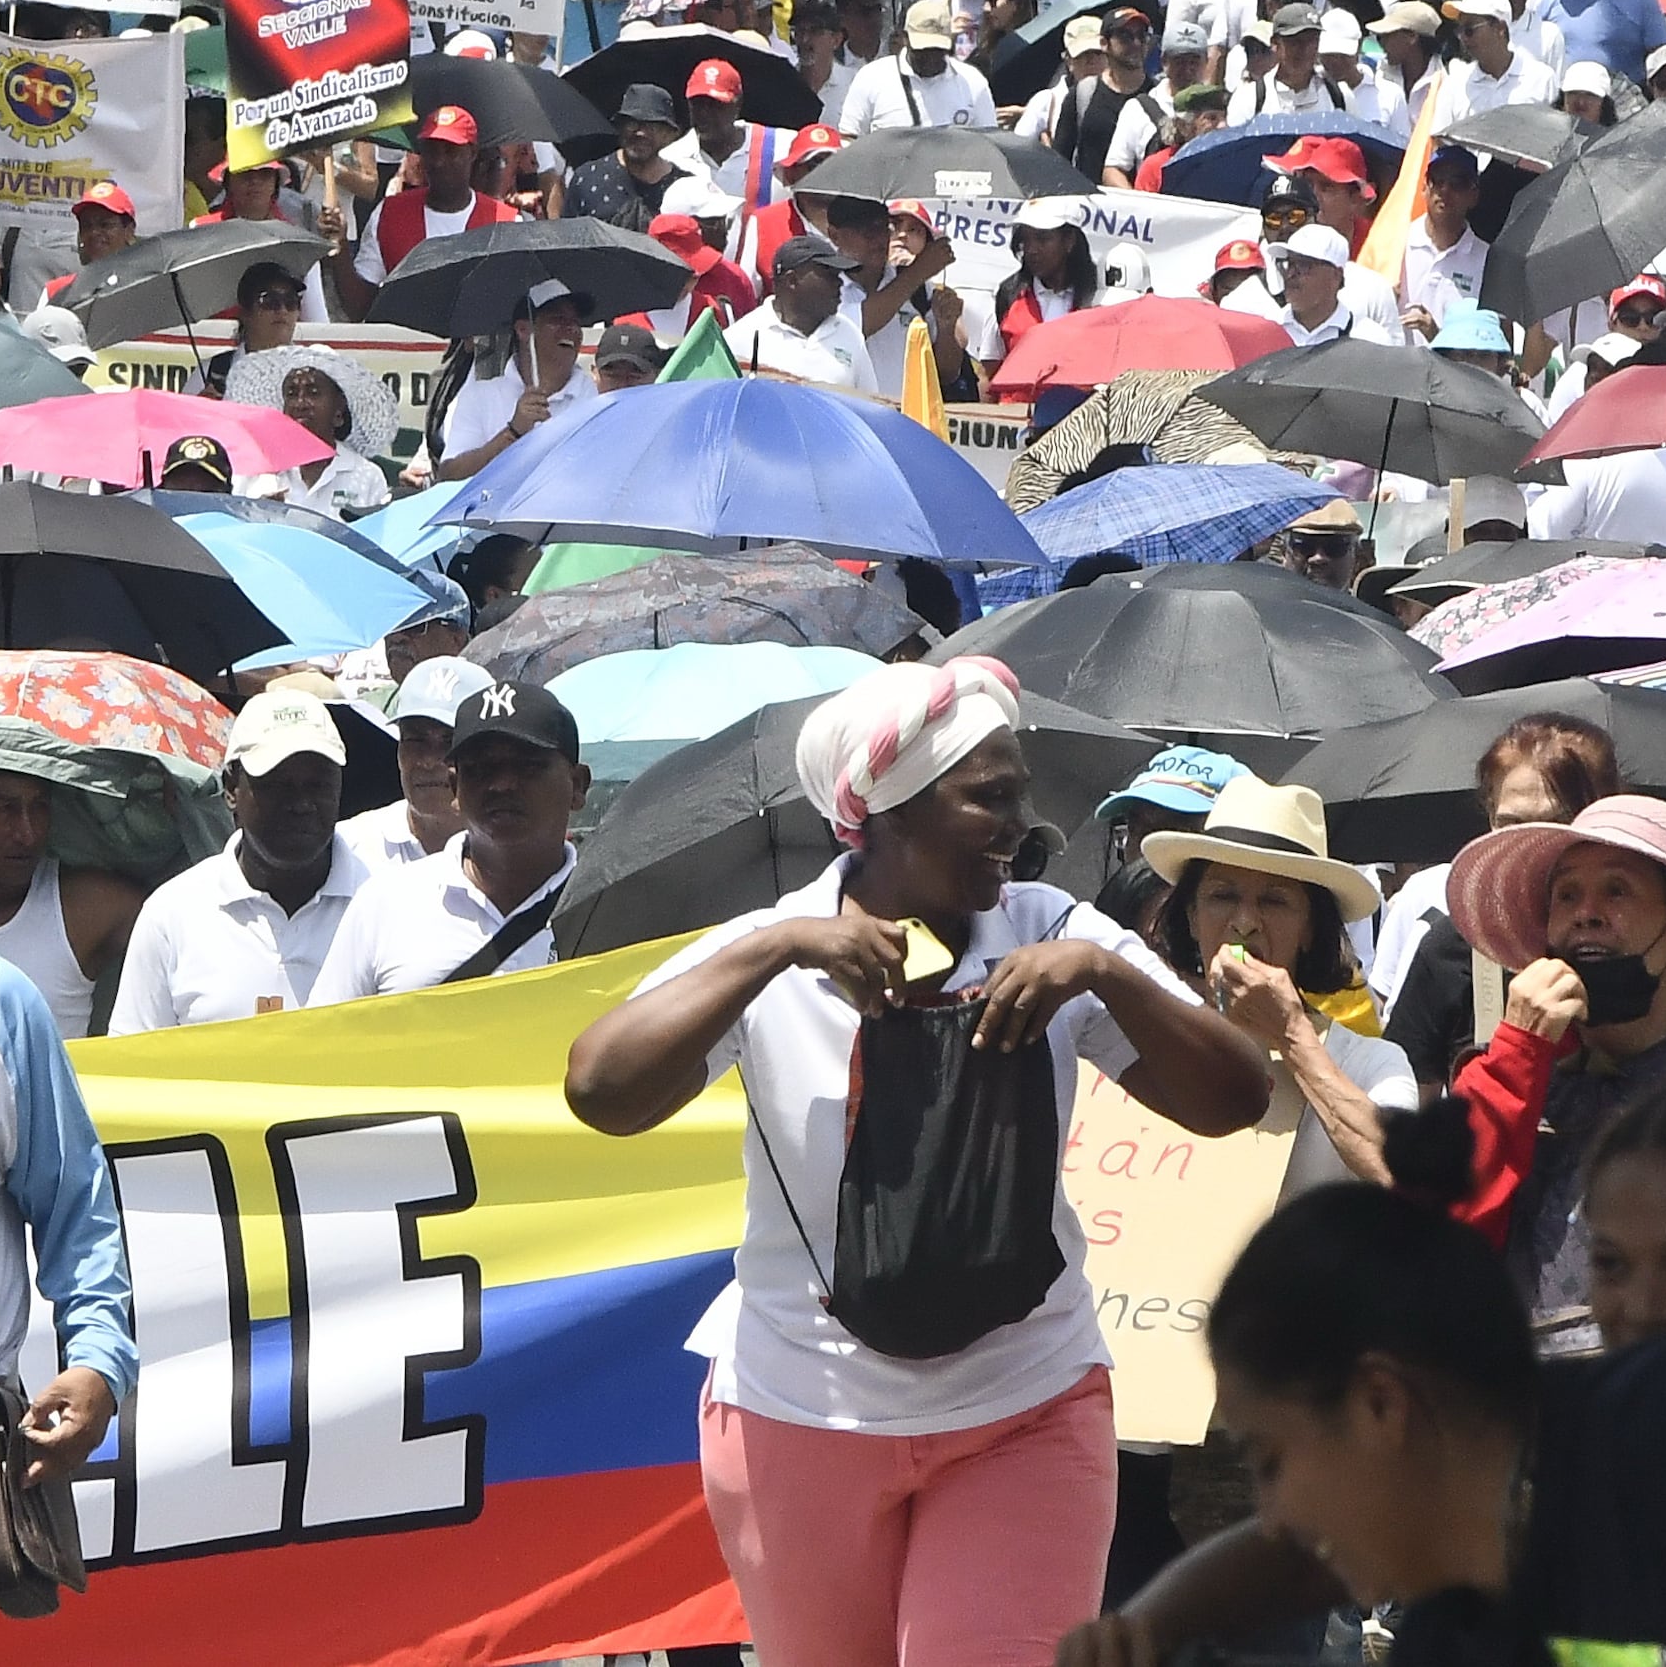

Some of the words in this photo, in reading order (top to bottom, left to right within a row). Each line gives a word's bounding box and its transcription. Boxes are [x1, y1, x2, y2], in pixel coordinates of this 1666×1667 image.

[284, 15, 347, 48] VALLE
[9, 74, 73, 109] CTC
[233, 100, 266, 127] Por
[268, 95, 292, 115] un
[293, 65, 405, 109] Sindicalismo
[267, 121, 288, 146] de
[290, 99, 374, 138] Avanzada
[34, 160, 53, 174] DE
[479, 683, 518, 721] NY
